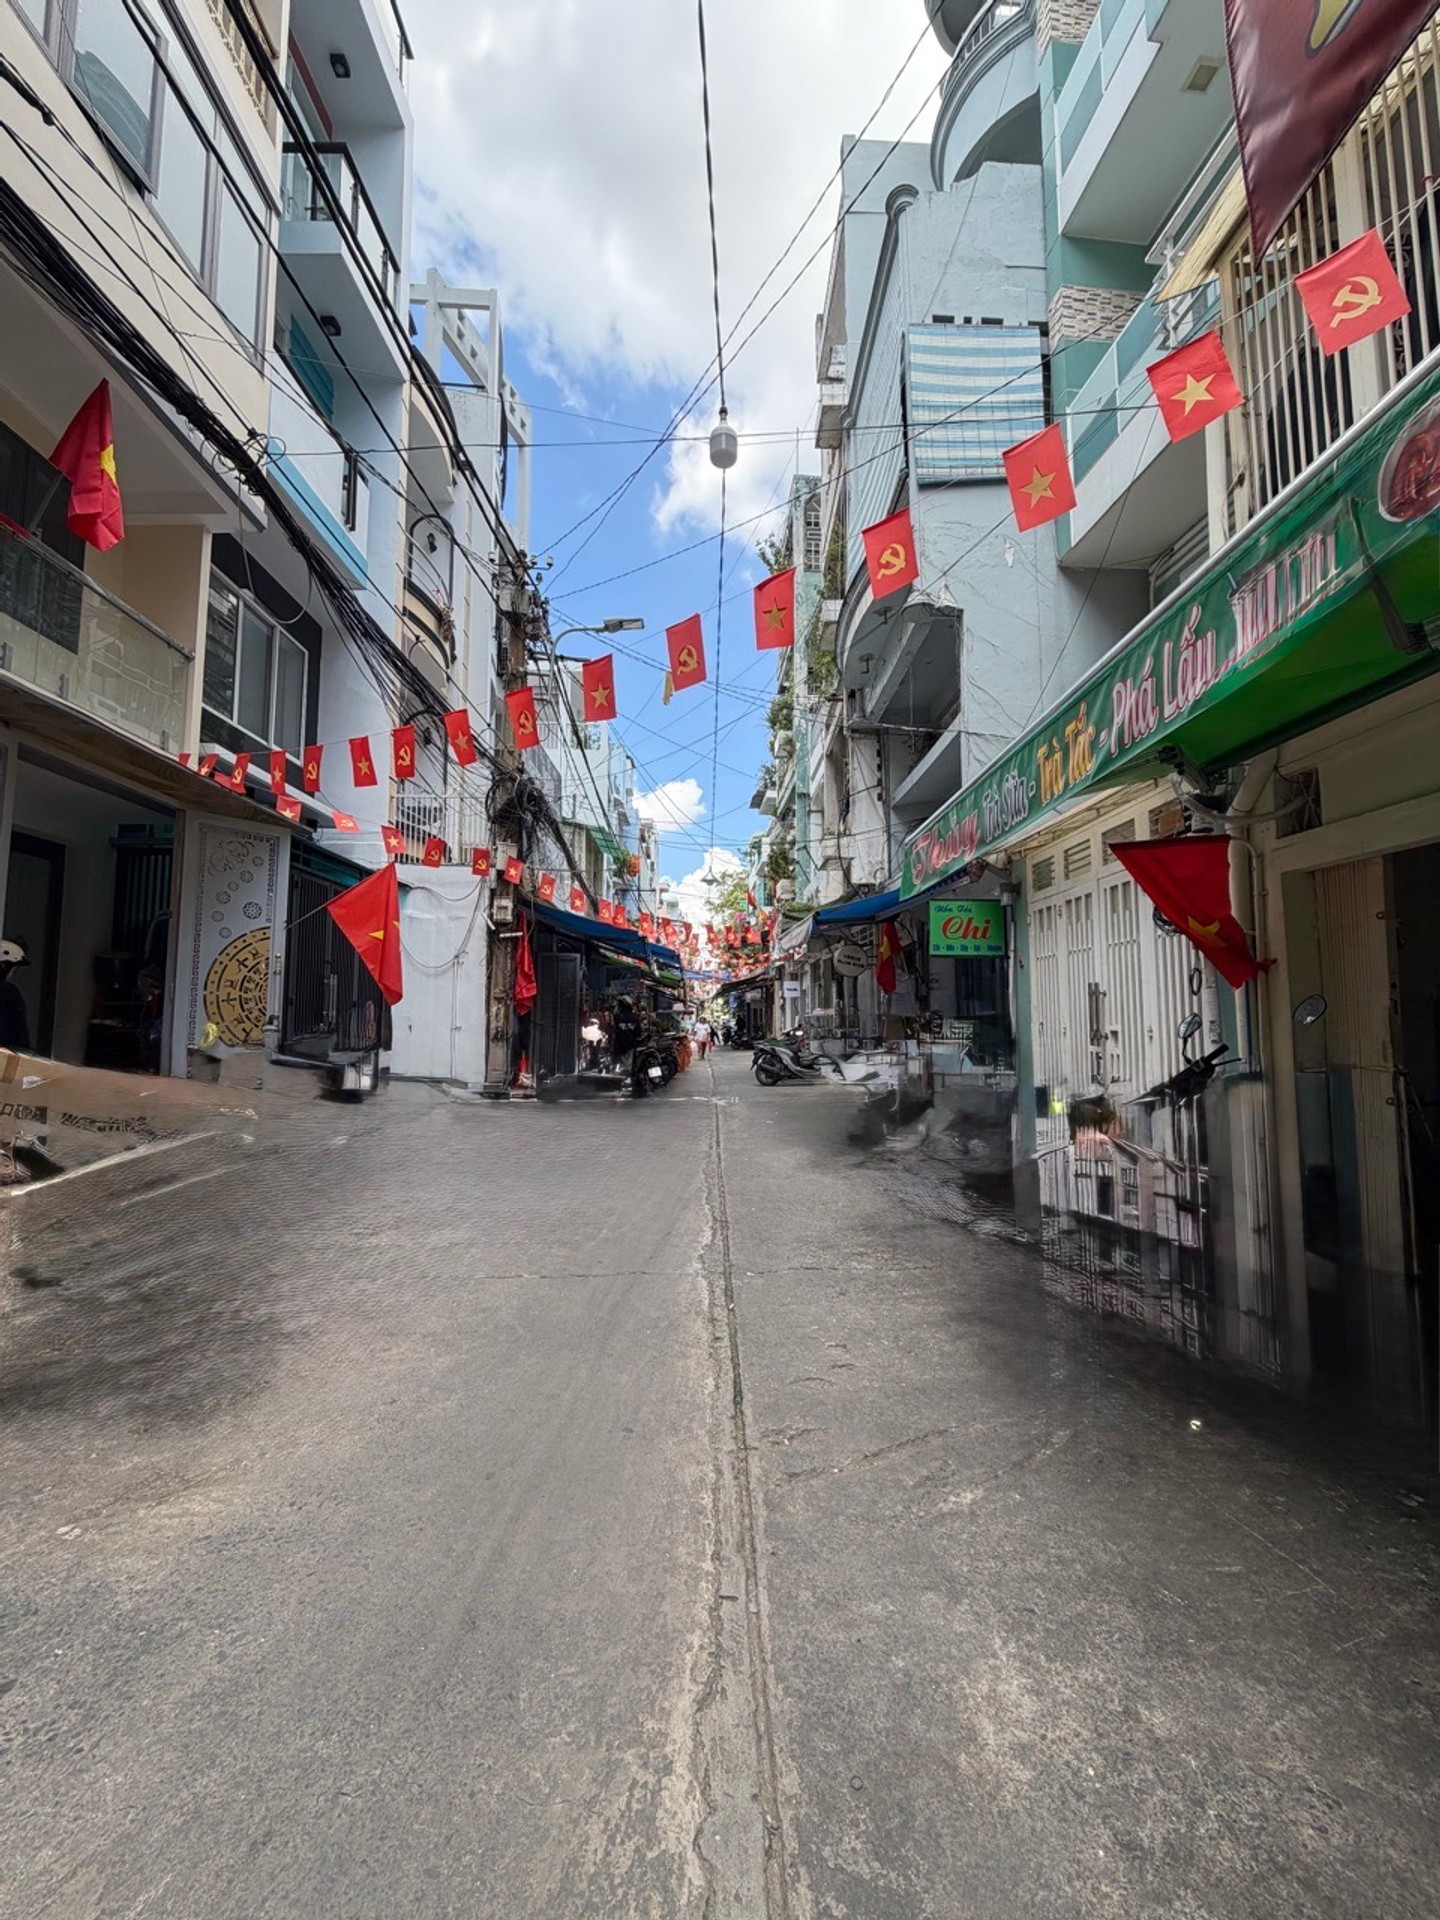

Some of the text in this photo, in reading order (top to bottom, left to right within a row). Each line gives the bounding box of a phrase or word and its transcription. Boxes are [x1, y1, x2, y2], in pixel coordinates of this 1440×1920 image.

[1037, 736, 1065, 806] Trà
[1110, 656, 1158, 757] Phá
[942, 916, 992, 941] Chi
